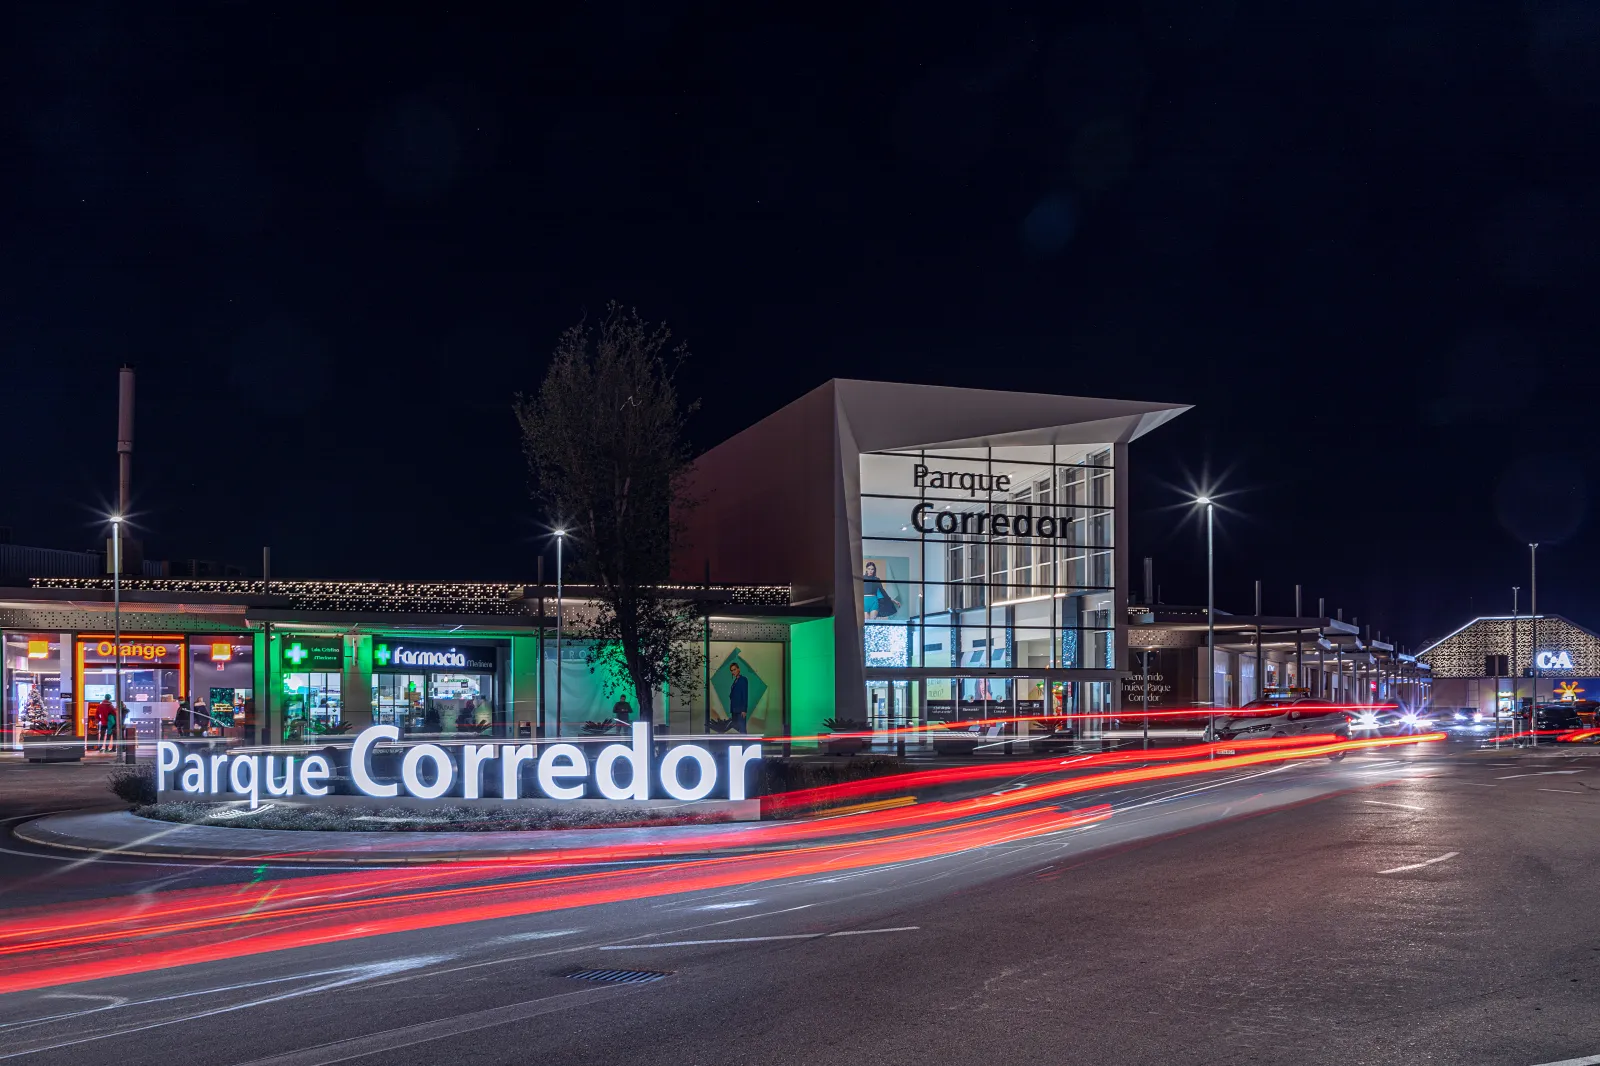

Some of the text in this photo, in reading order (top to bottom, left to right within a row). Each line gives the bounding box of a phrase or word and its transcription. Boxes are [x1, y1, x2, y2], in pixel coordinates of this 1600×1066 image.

[913, 463, 1011, 497] Parque
[911, 502, 1074, 539] Corredor
[97, 641, 167, 660] Orange
[1128, 693, 1160, 702] Corrdor
[1147, 683, 1171, 692] Parque
[157, 721, 763, 808] Parque Corredor
